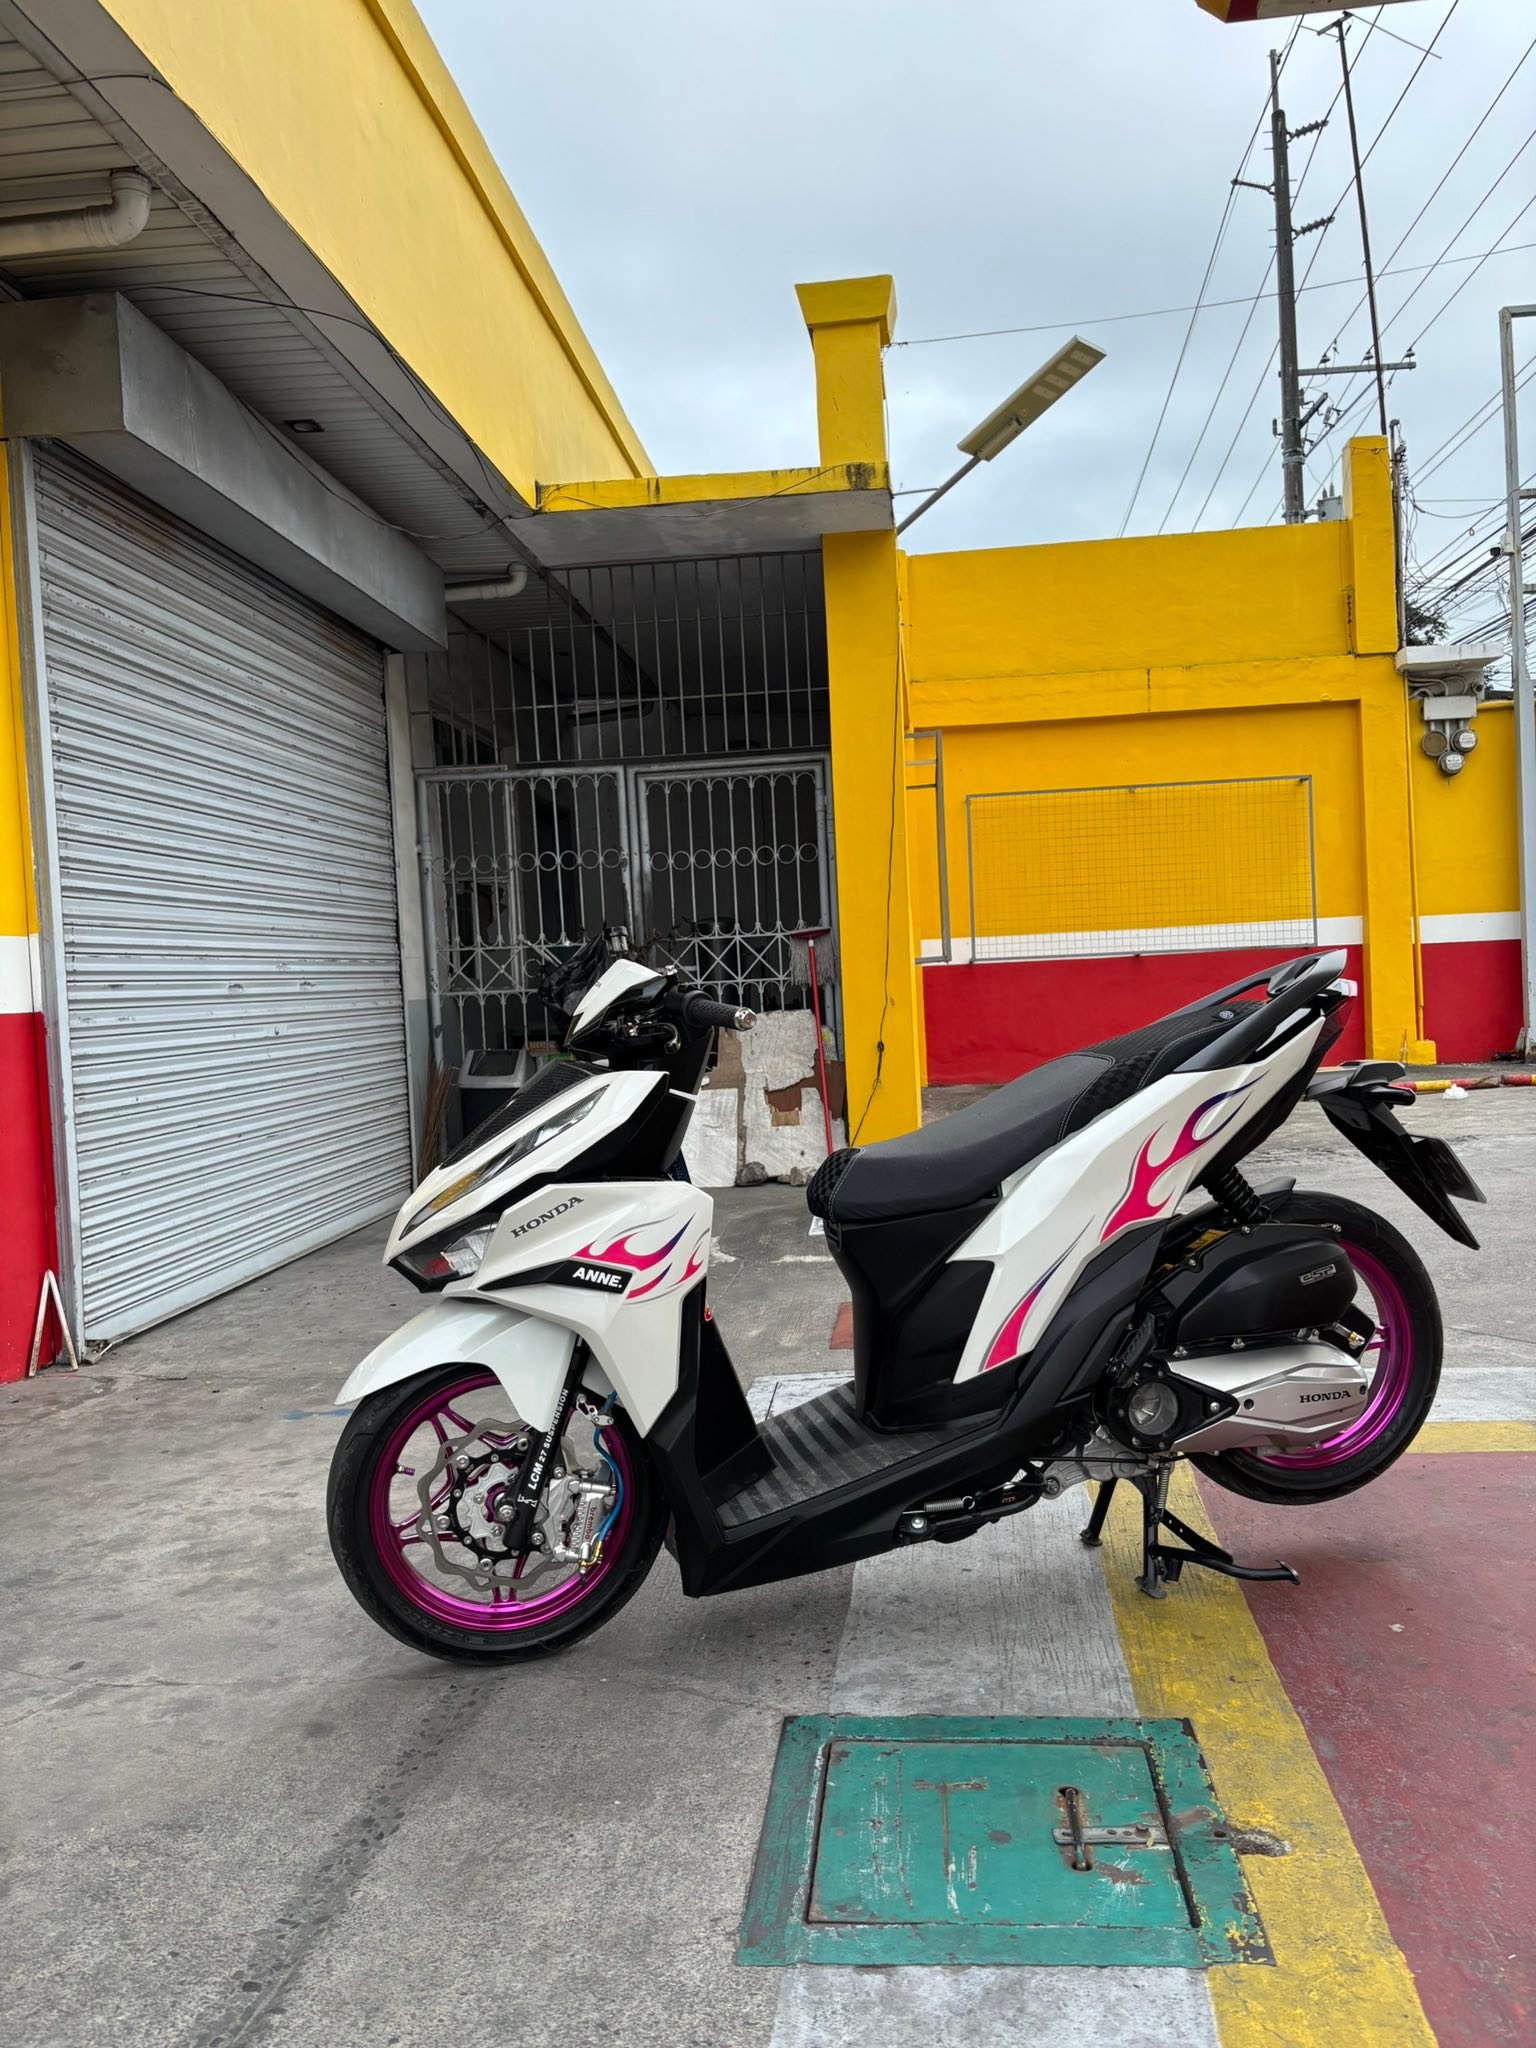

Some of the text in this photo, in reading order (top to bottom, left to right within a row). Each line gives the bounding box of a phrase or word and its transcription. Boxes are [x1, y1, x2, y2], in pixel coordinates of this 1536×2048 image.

[510, 1196, 584, 1238] HONDA
[572, 1266, 622, 1289] ANNE.
[1300, 1390, 1351, 1404] HONDA
[528, 1388, 569, 1490] LCM 27 SUSPENSION
[585, 1507, 597, 1539] brembo
